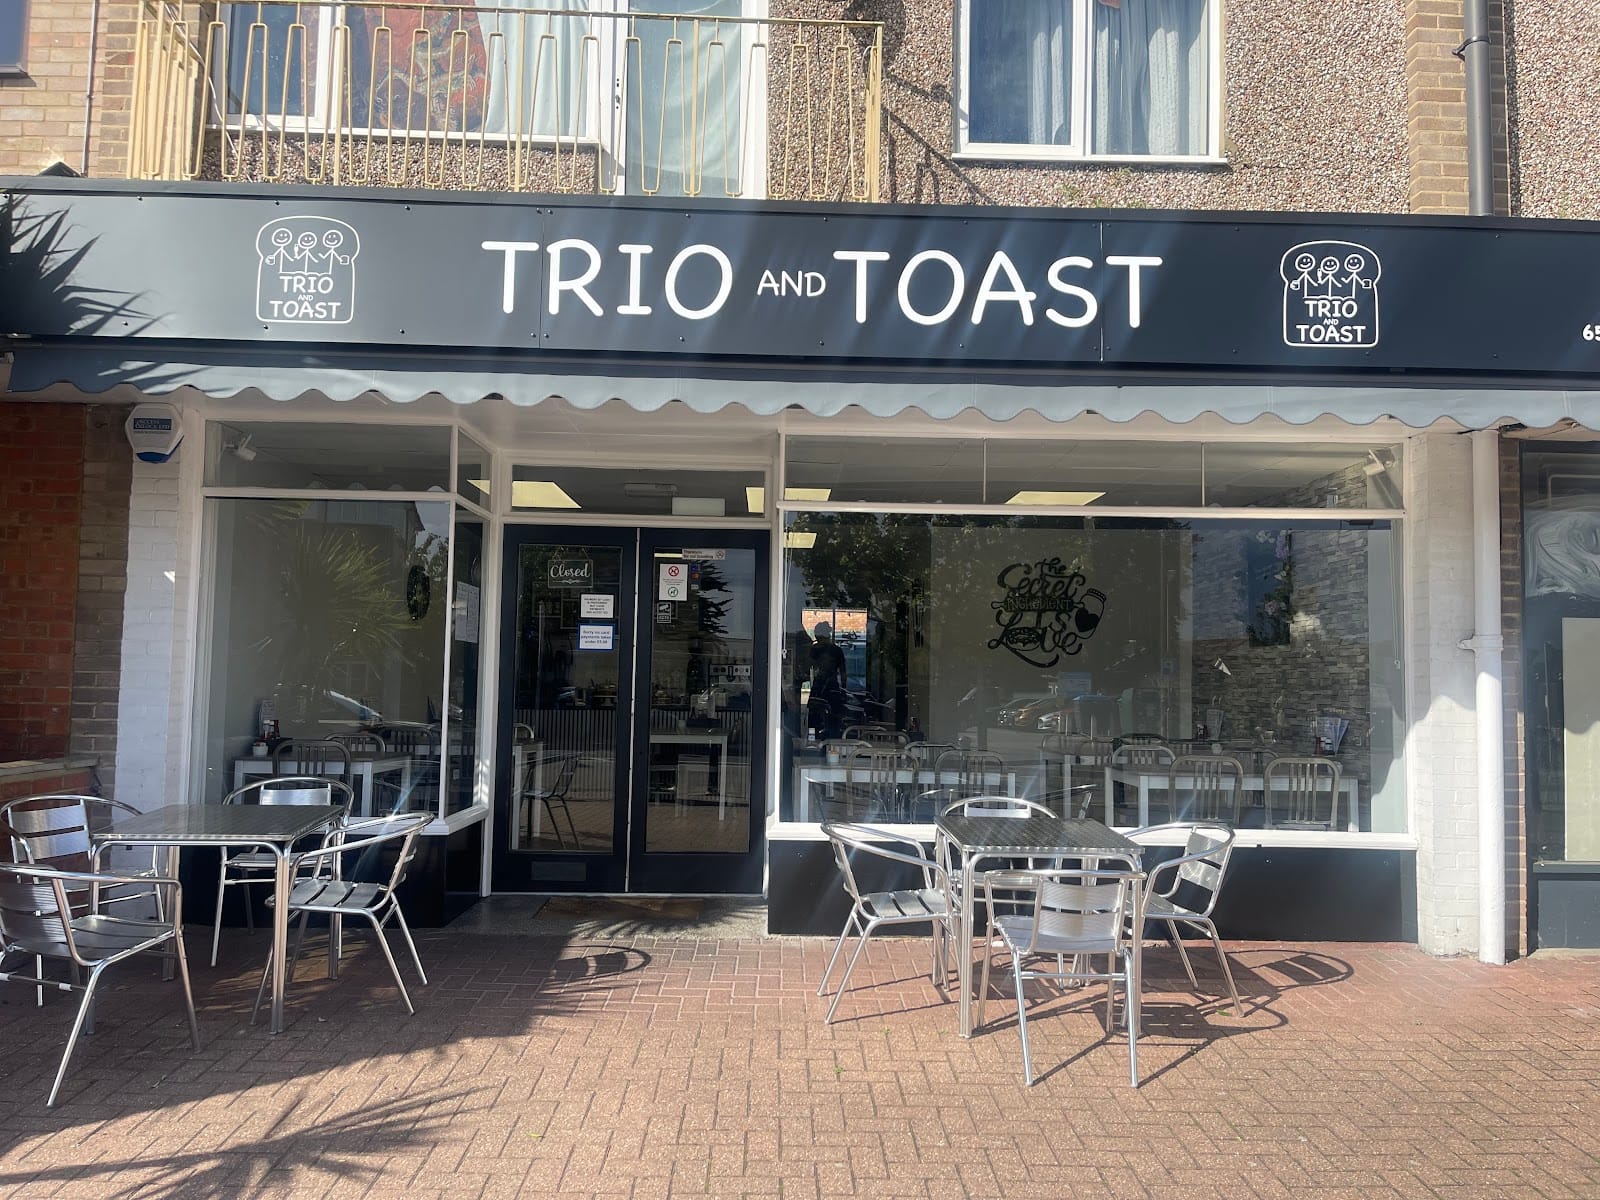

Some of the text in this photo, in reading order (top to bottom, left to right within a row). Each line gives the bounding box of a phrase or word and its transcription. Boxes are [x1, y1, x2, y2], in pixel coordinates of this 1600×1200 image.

[279, 275, 334, 294] TRIO
[481, 239, 1163, 329] TRIO AND TOAST
[297, 294, 314, 302] AND
[269, 300, 342, 319] TOAST
[1304, 299, 1358, 318] TRIO
[1322, 318, 1339, 326] AND
[1295, 324, 1367, 343] TOAST
[550, 562, 590, 578] Closed
